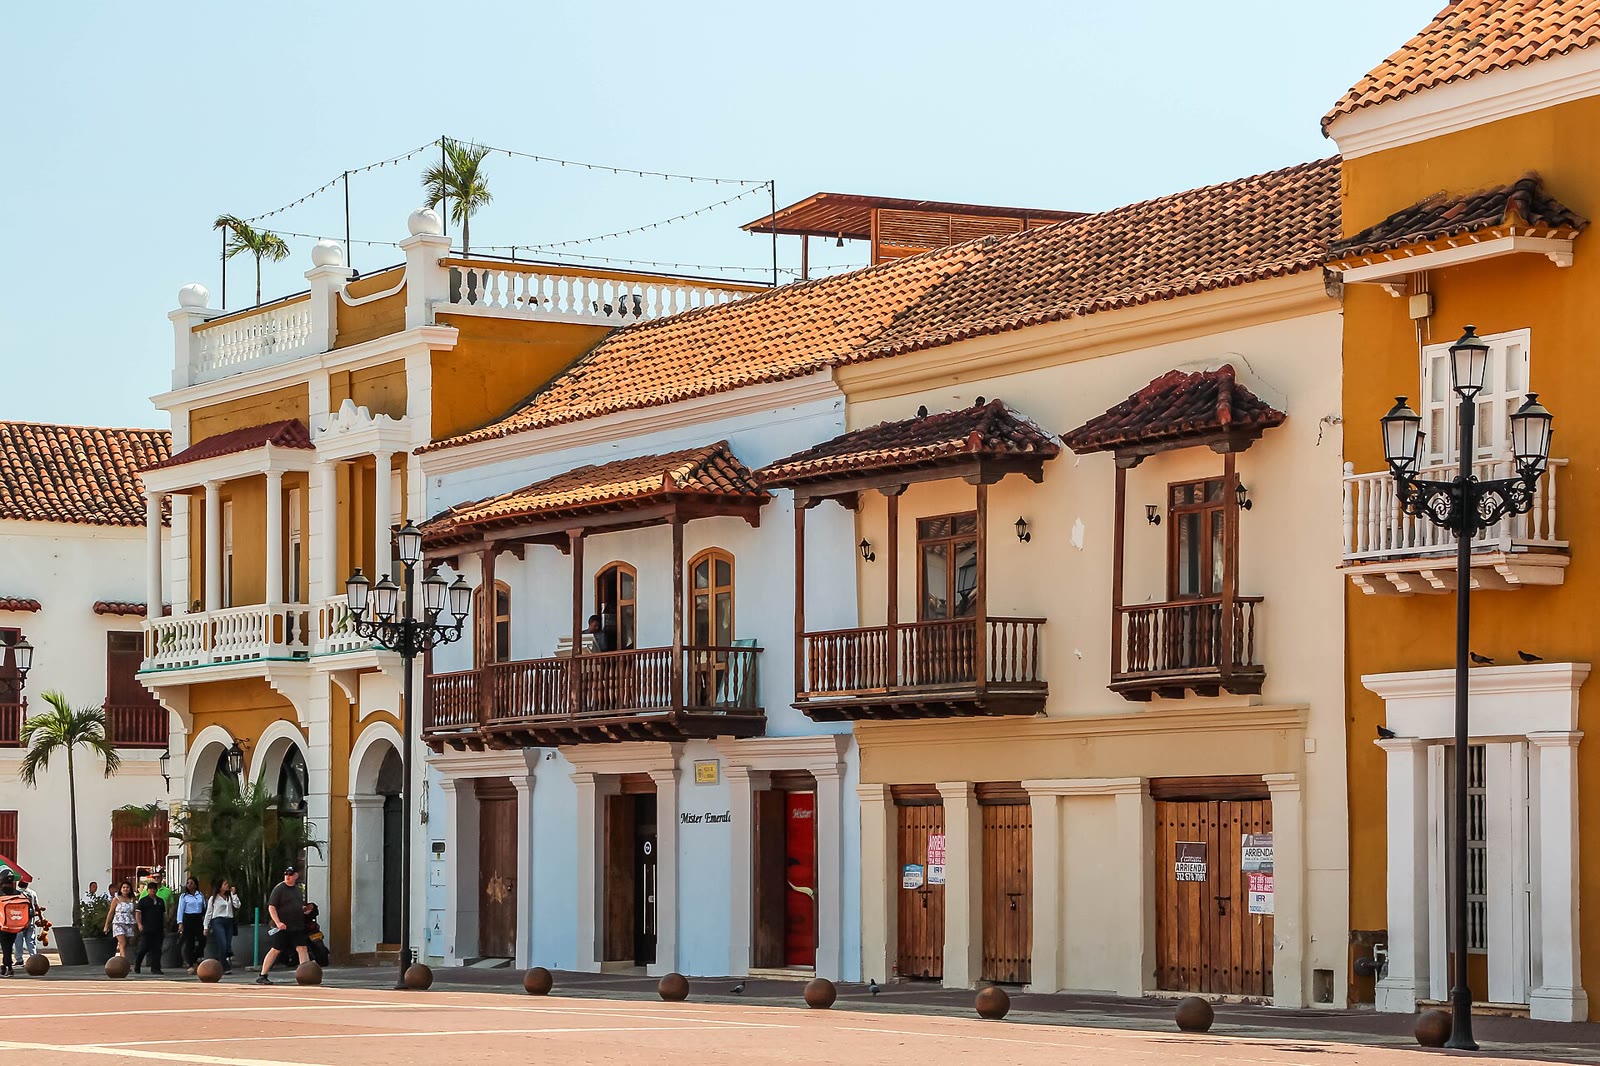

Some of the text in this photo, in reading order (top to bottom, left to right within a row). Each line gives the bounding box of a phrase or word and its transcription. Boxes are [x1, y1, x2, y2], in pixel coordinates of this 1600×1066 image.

[681, 812, 703, 824] Mister
[1245, 848, 1273, 857] ARRIENDA
[1176, 863, 1205, 872] ARRIENDA
